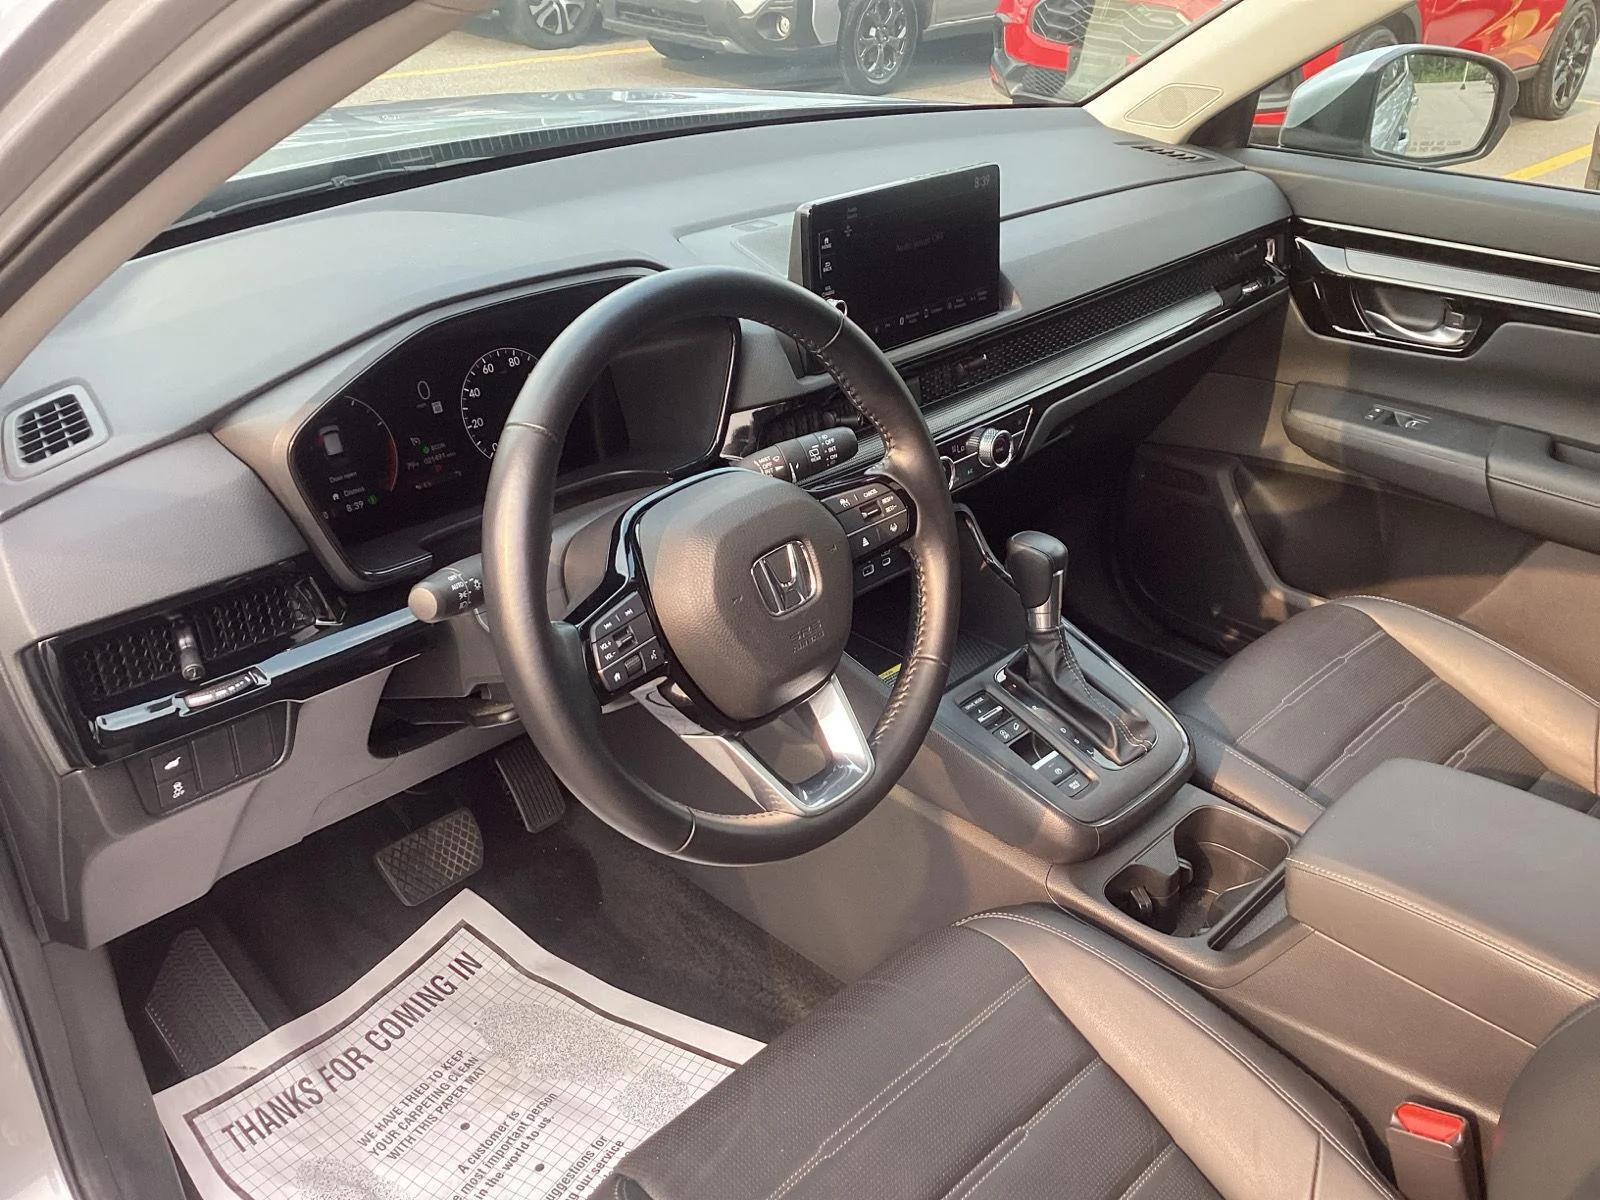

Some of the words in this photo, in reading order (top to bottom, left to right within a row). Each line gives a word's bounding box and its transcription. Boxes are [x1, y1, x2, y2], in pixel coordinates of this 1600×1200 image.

[974, 174, 990, 189] 8:39
[417, 380, 431, 400] 0
[482, 363, 494, 374] 60
[509, 356, 520, 367] 80
[469, 387, 480, 398] 40
[472, 418, 484, 429] 20
[346, 500, 364, 512] 8:39
[221, 1077, 323, 1153] THANKS
[317, 1046, 374, 1093] FOR
[364, 975, 458, 1051] COMING
[448, 951, 483, 981] IN
[356, 1129, 378, 1147] WE
[374, 1106, 403, 1132] HAVE
[399, 1082, 430, 1108] TRIED
[427, 1070, 443, 1083] TO
[440, 1049, 465, 1071] KEEP
[368, 1129, 401, 1157] YOUR
[397, 1082, 451, 1131] CARPETING
[448, 1056, 479, 1082] CLEAN
[387, 1134, 417, 1160] WITH
[412, 1114, 438, 1135] THIS
[435, 1084, 468, 1114] PAPER
[464, 1066, 486, 1085] MAT
[458, 1164, 470, 1174] A
[467, 1120, 510, 1165] customer
[506, 1110, 520, 1121] is
[461, 1168, 487, 1194] most
[482, 1121, 530, 1169] important
[526, 1092, 558, 1122] person
[474, 1188, 488, 1200] in
[485, 1171, 505, 1188] the
[502, 1141, 530, 1171] world
[526, 1130, 540, 1141] to
[538, 1116, 555, 1129] us.
[545, 1150, 595, 1200] uggestions
[590, 1135, 608, 1151] for
[575, 1174, 593, 1192] our
[591, 1140, 625, 1175] service
